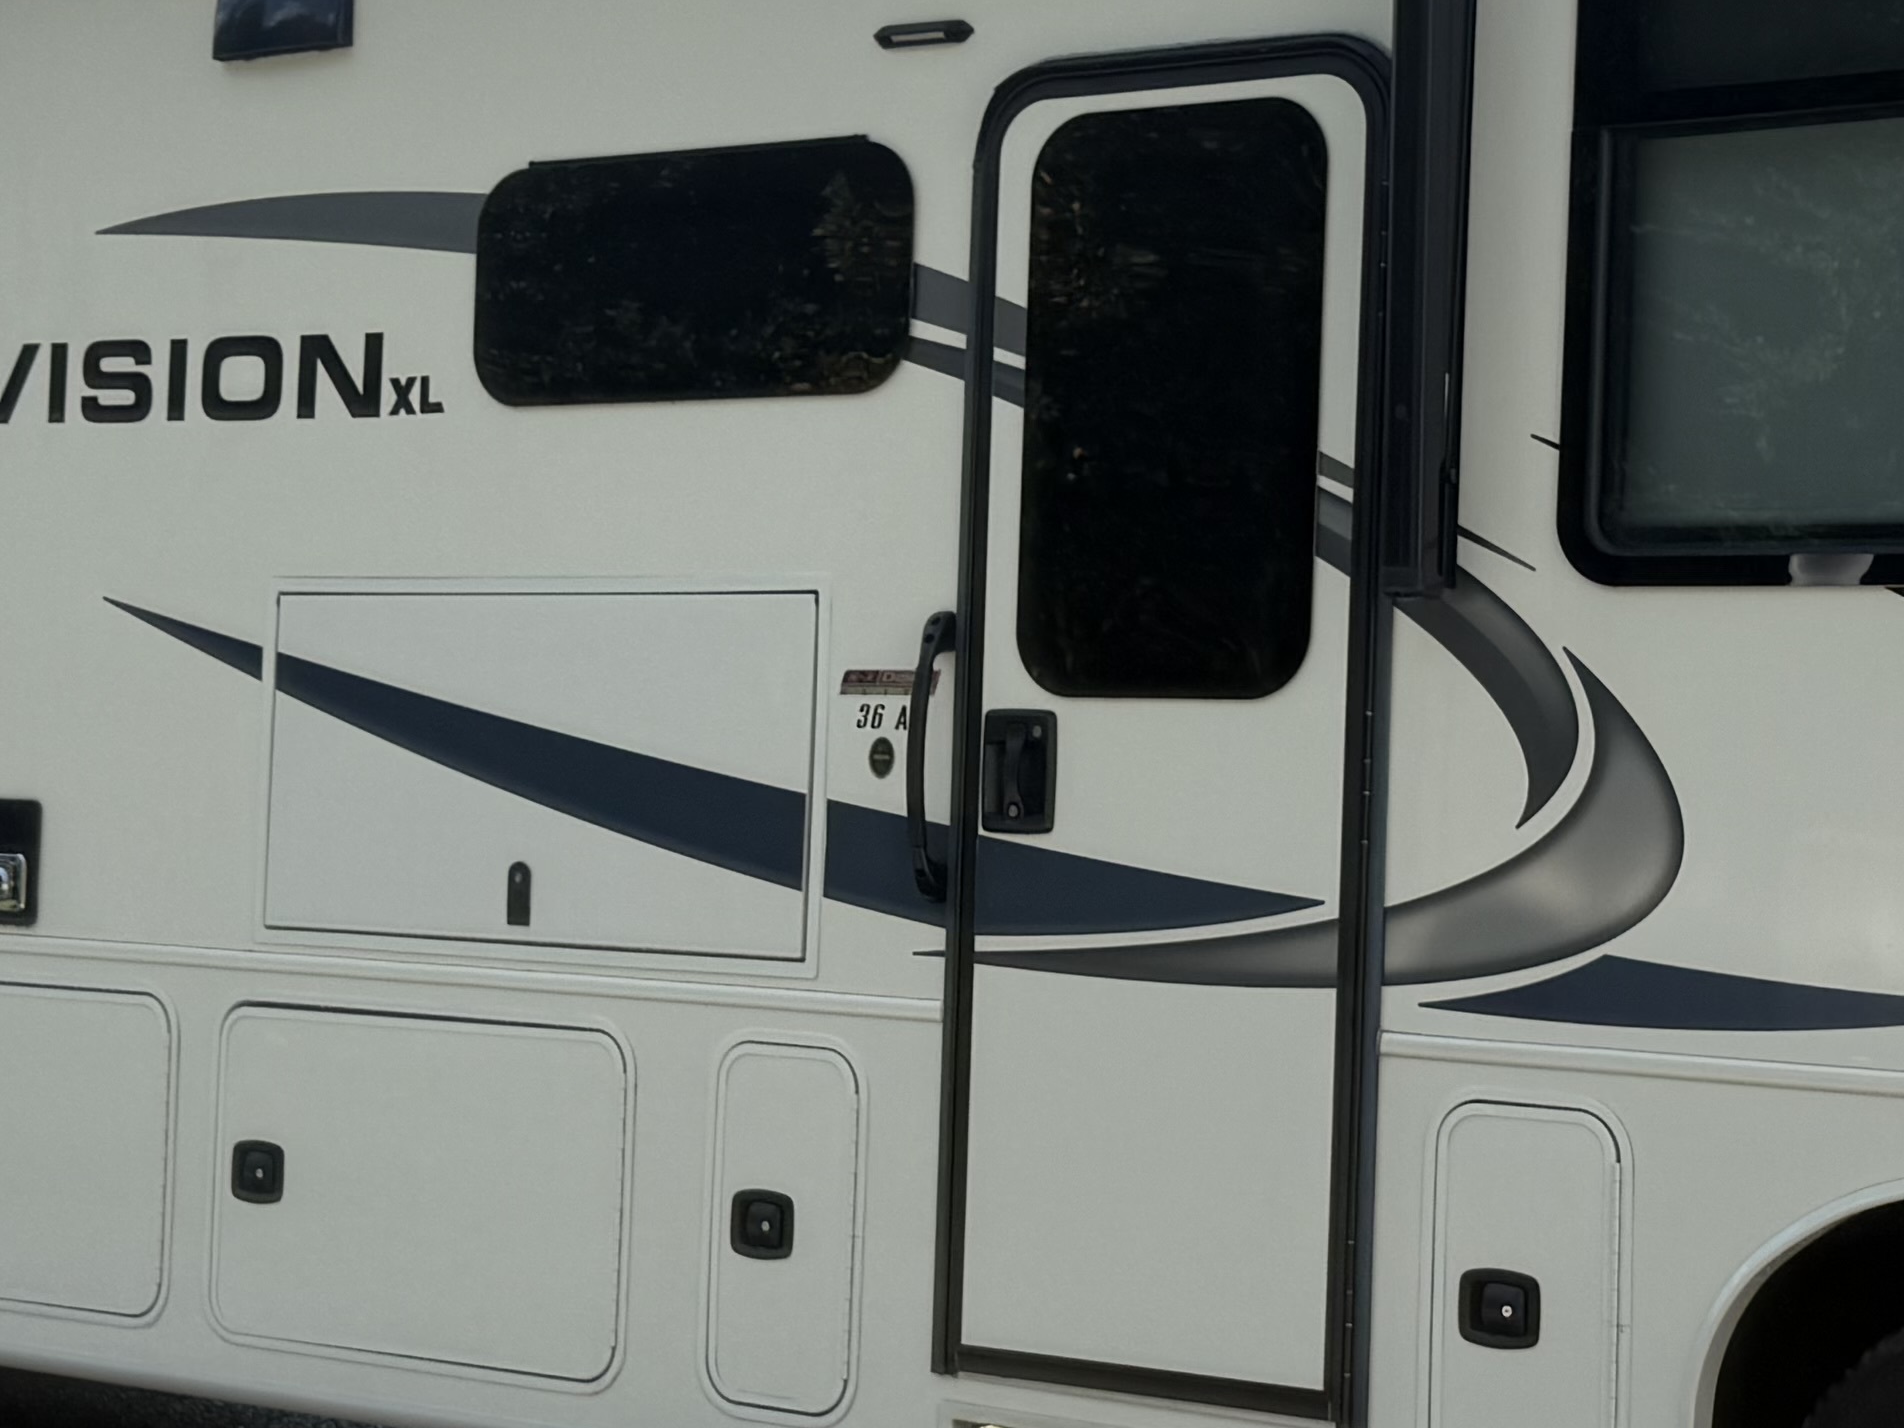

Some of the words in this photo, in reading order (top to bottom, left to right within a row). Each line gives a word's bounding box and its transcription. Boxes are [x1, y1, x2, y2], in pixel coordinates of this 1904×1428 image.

[388, 375, 445, 416] XL
[856, 703, 886, 729] 36
[894, 704, 908, 730] A
